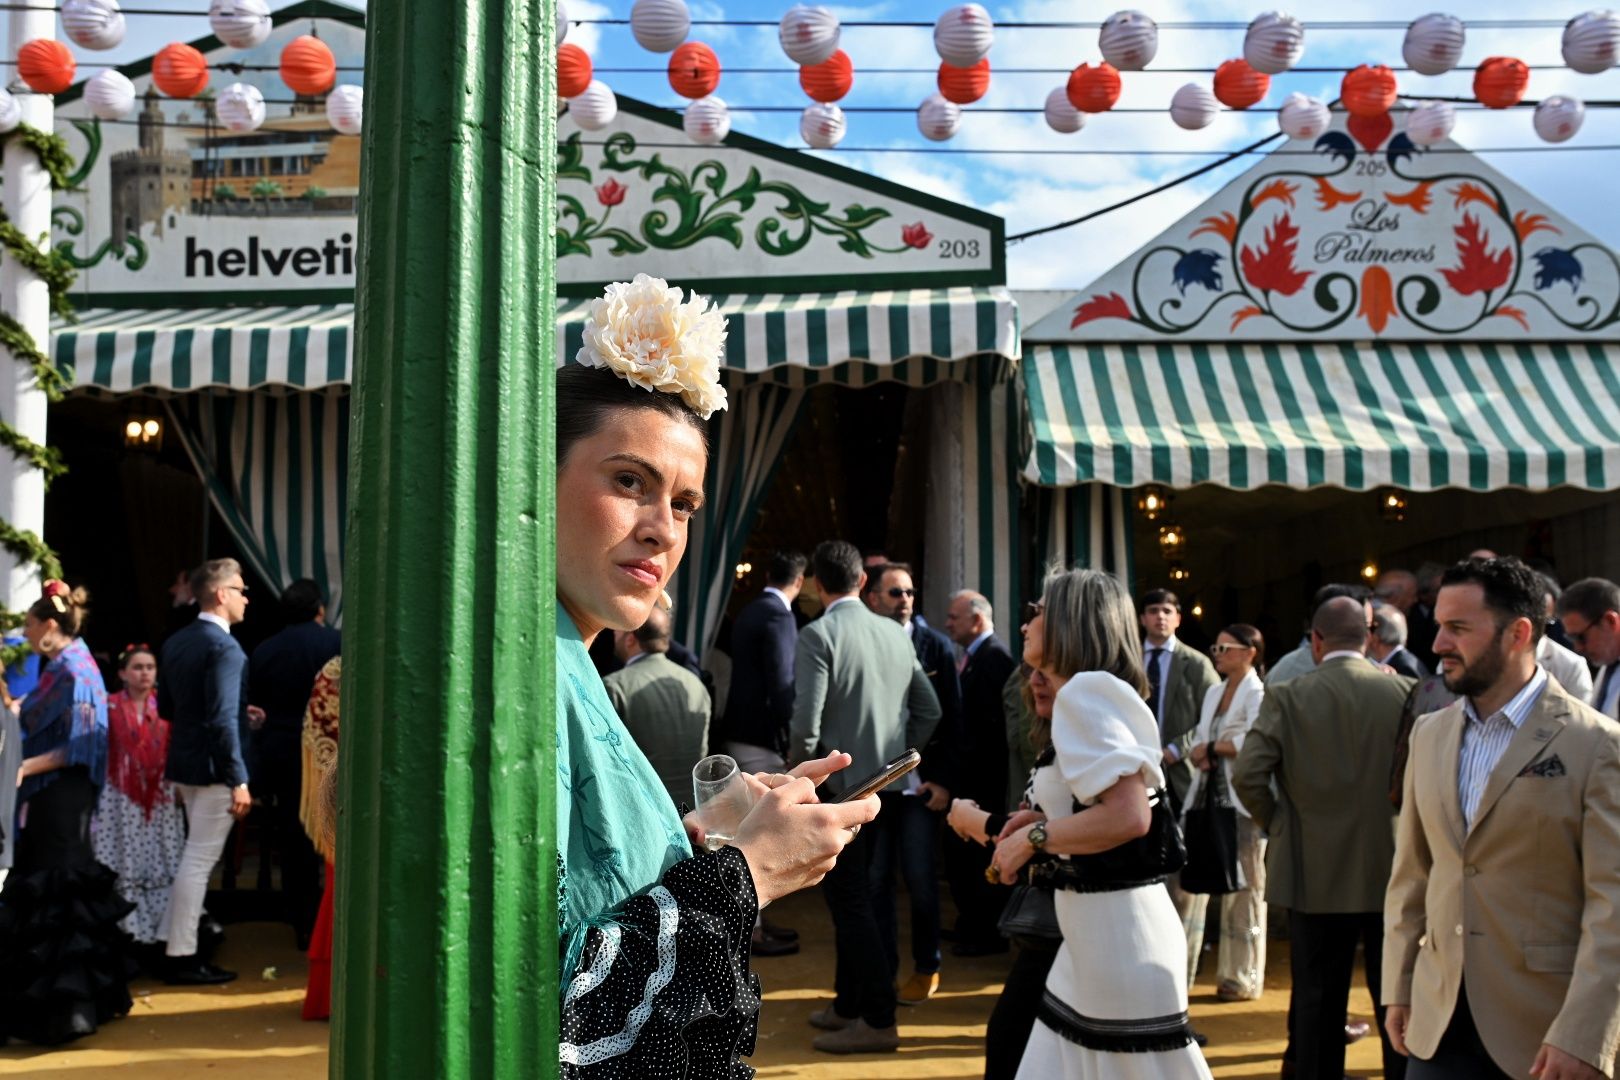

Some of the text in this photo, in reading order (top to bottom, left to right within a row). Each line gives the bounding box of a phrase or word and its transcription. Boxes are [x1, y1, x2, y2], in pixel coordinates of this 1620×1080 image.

[1355, 160, 1387, 176] 205
[1346, 198, 1400, 232] Los
[185, 232, 356, 277] helveti
[939, 239, 980, 259] 203
[1313, 231, 1436, 264] Palmeros
